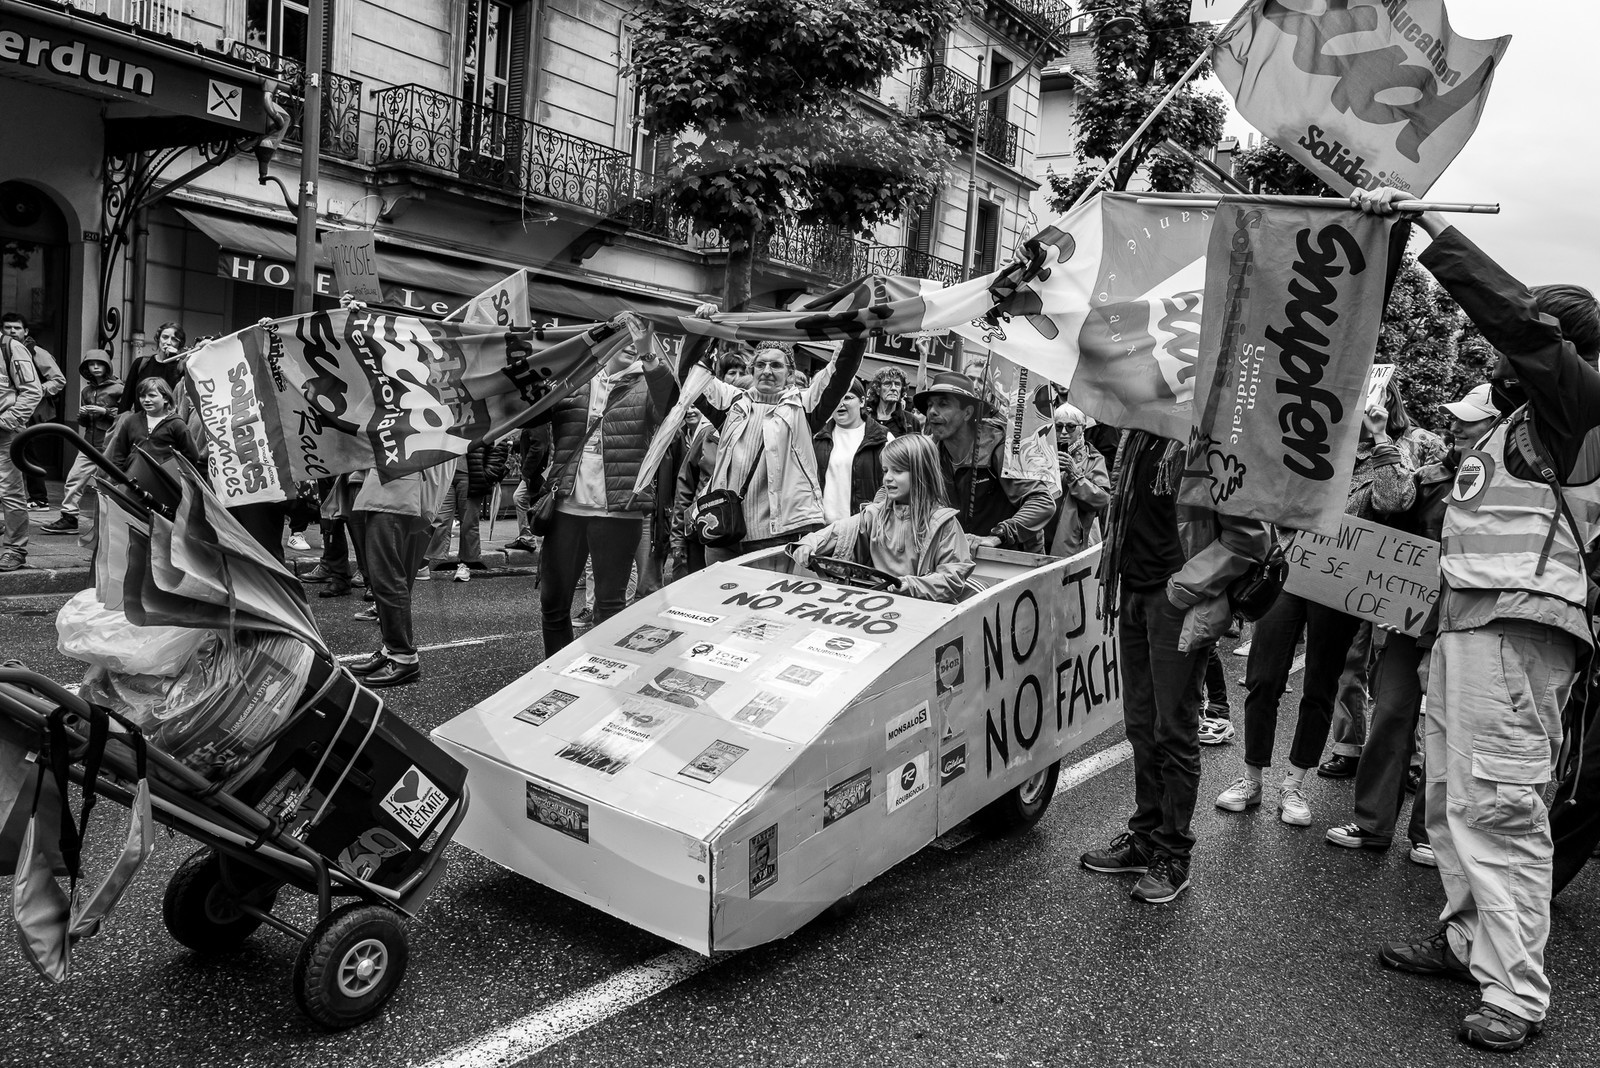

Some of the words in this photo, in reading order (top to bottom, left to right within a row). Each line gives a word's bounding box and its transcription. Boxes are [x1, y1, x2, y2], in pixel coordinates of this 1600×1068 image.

[1389, 170, 1411, 190] Union
[1230, 342, 1254, 445] Syndicale
[1245, 344, 1266, 411] Union
[216, 404, 243, 497] Finances
[227, 361, 268, 494] Solidaires
[293, 406, 331, 476] Rail
[766, 579, 822, 595] NO
[1289, 544, 1316, 569] DE
[1320, 556, 1350, 579] SE
[1365, 569, 1440, 606] METTRE
[721, 591, 783, 610] NO
[784, 602, 898, 635] FACHO
[983, 589, 1040, 692] NO
[986, 674, 1043, 779] NO
[1056, 637, 1121, 732] FACH
[395, 804, 415, 823] MA
